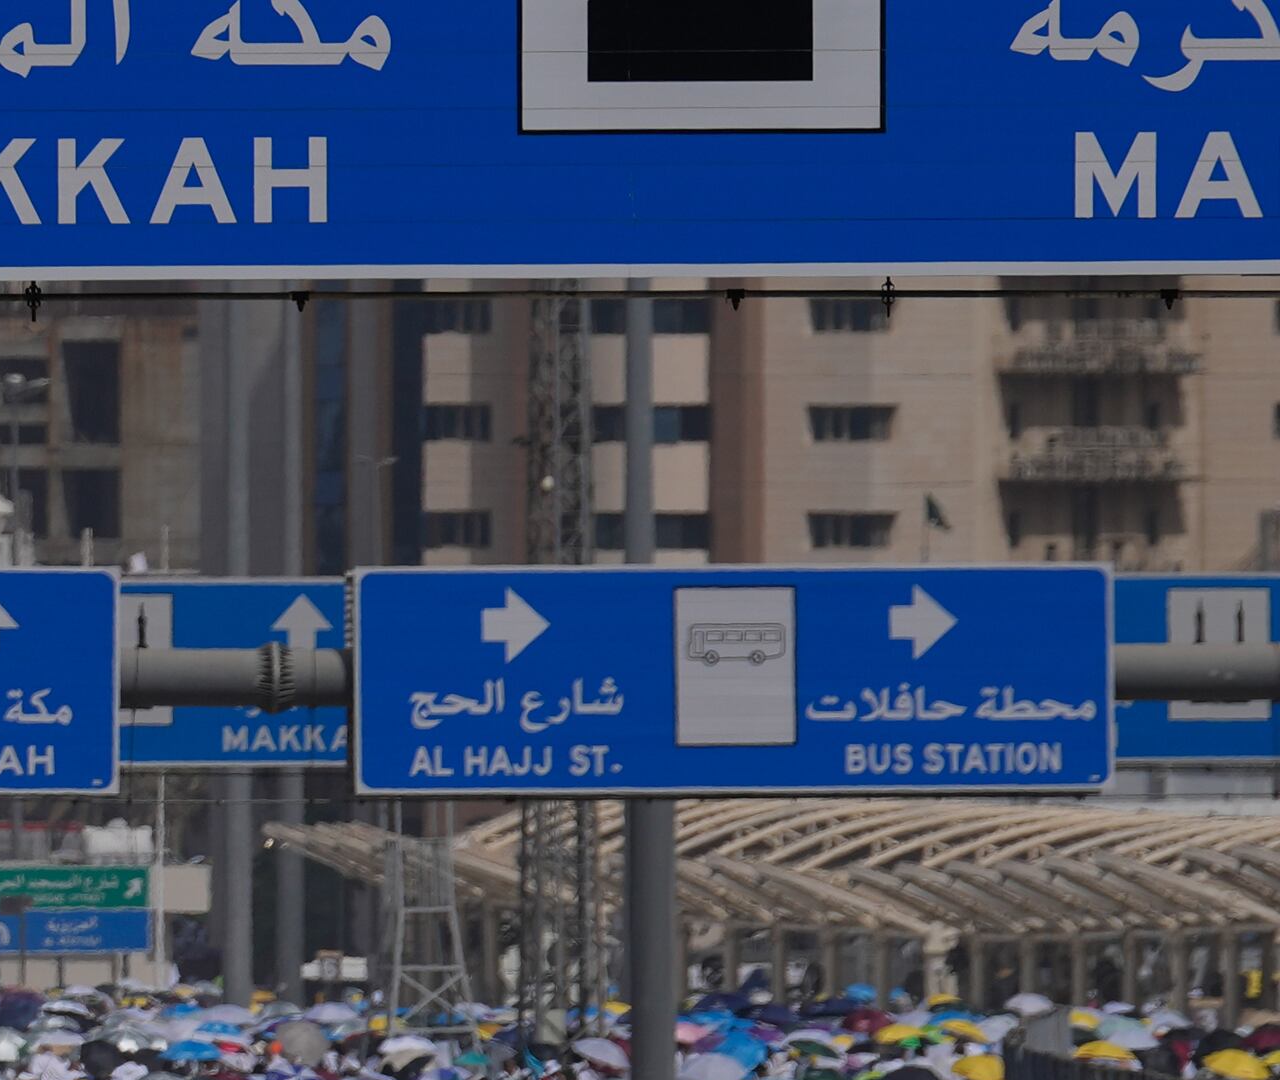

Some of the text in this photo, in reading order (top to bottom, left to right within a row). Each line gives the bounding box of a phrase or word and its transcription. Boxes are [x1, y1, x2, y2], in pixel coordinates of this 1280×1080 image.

[4, 688, 73, 725] مكة
[410, 677, 624, 732] شارع الحج
[805, 683, 1097, 722] محطة حافلات
[410, 744, 623, 777] AL HAJJ ST.
[845, 742, 1062, 774] BUS STATION
